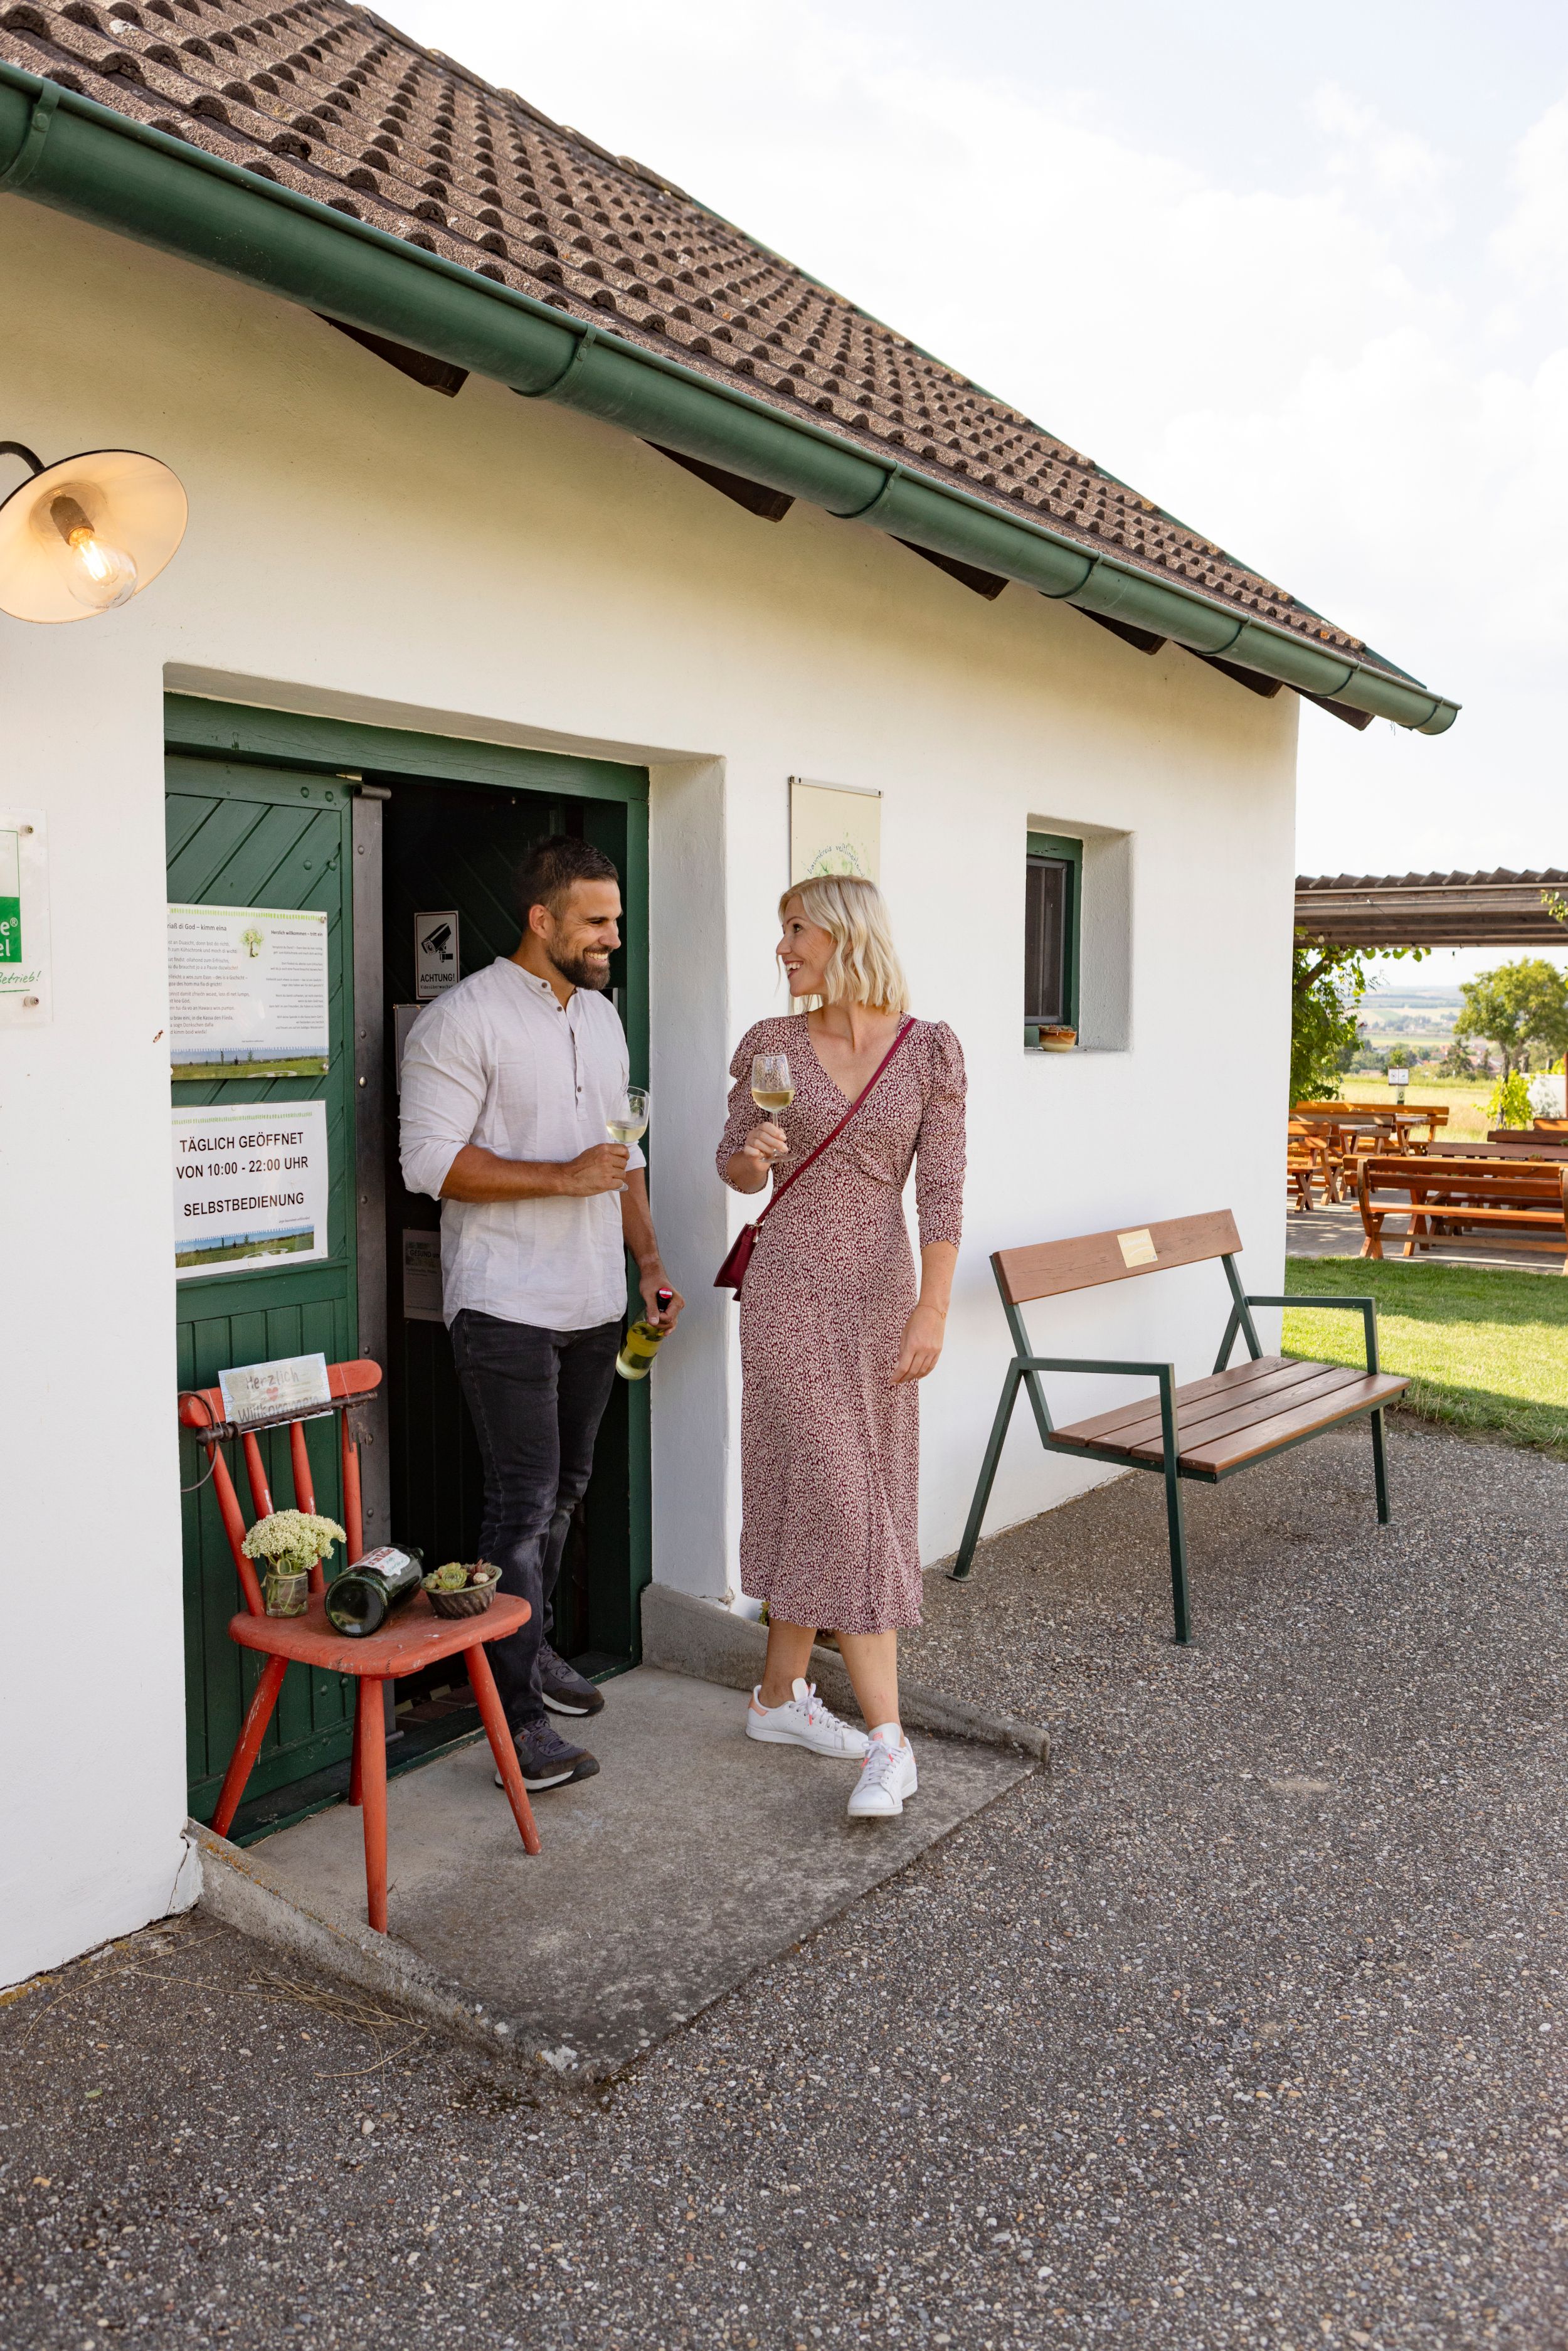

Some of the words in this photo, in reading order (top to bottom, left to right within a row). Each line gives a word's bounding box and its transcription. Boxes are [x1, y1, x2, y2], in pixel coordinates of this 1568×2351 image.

[420, 973, 455, 982] ACHTUNG!
[179, 1137, 235, 1153] TÄGLICH
[238, 1131, 304, 1149] GEÖFFNET
[176, 1164, 204, 1179] VON
[208, 1162, 238, 1177] 10:00
[248, 1159, 280, 1173] 22:00
[284, 1156, 309, 1170] UHR
[184, 1192, 305, 1217] SELBSTBEDIENUNG
[245, 1367, 299, 1390] Herzlich
